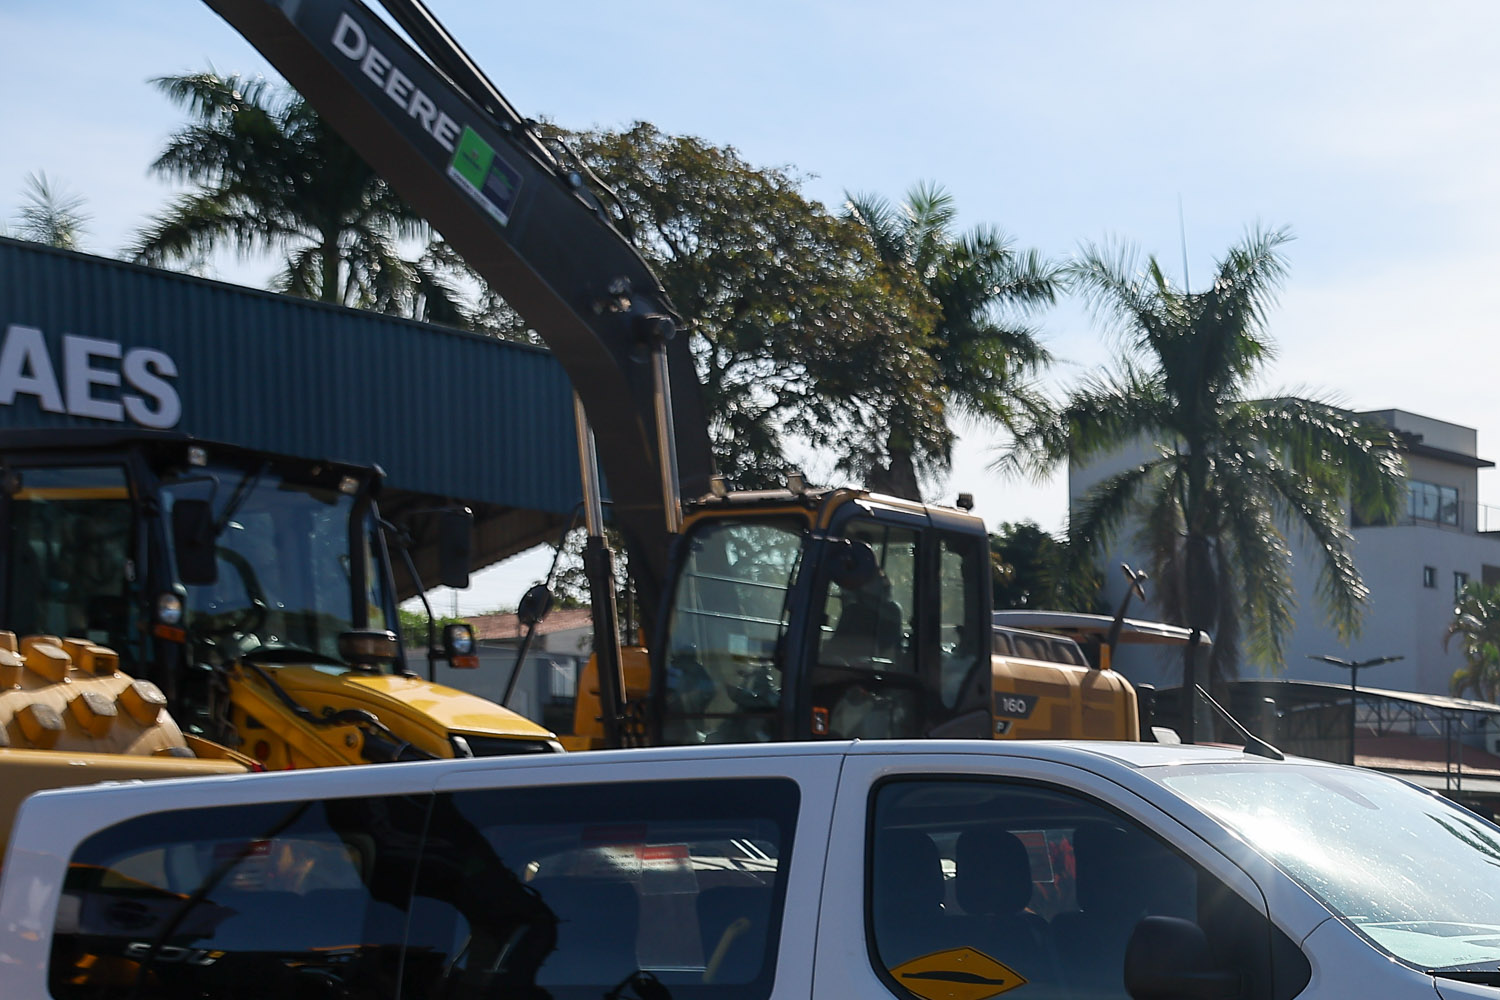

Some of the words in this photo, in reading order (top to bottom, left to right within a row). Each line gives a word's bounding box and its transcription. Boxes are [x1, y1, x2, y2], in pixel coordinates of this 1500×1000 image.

[331, 11, 462, 154] DEERE
[0, 323, 183, 430] AES
[1002, 696, 1027, 714] 160
